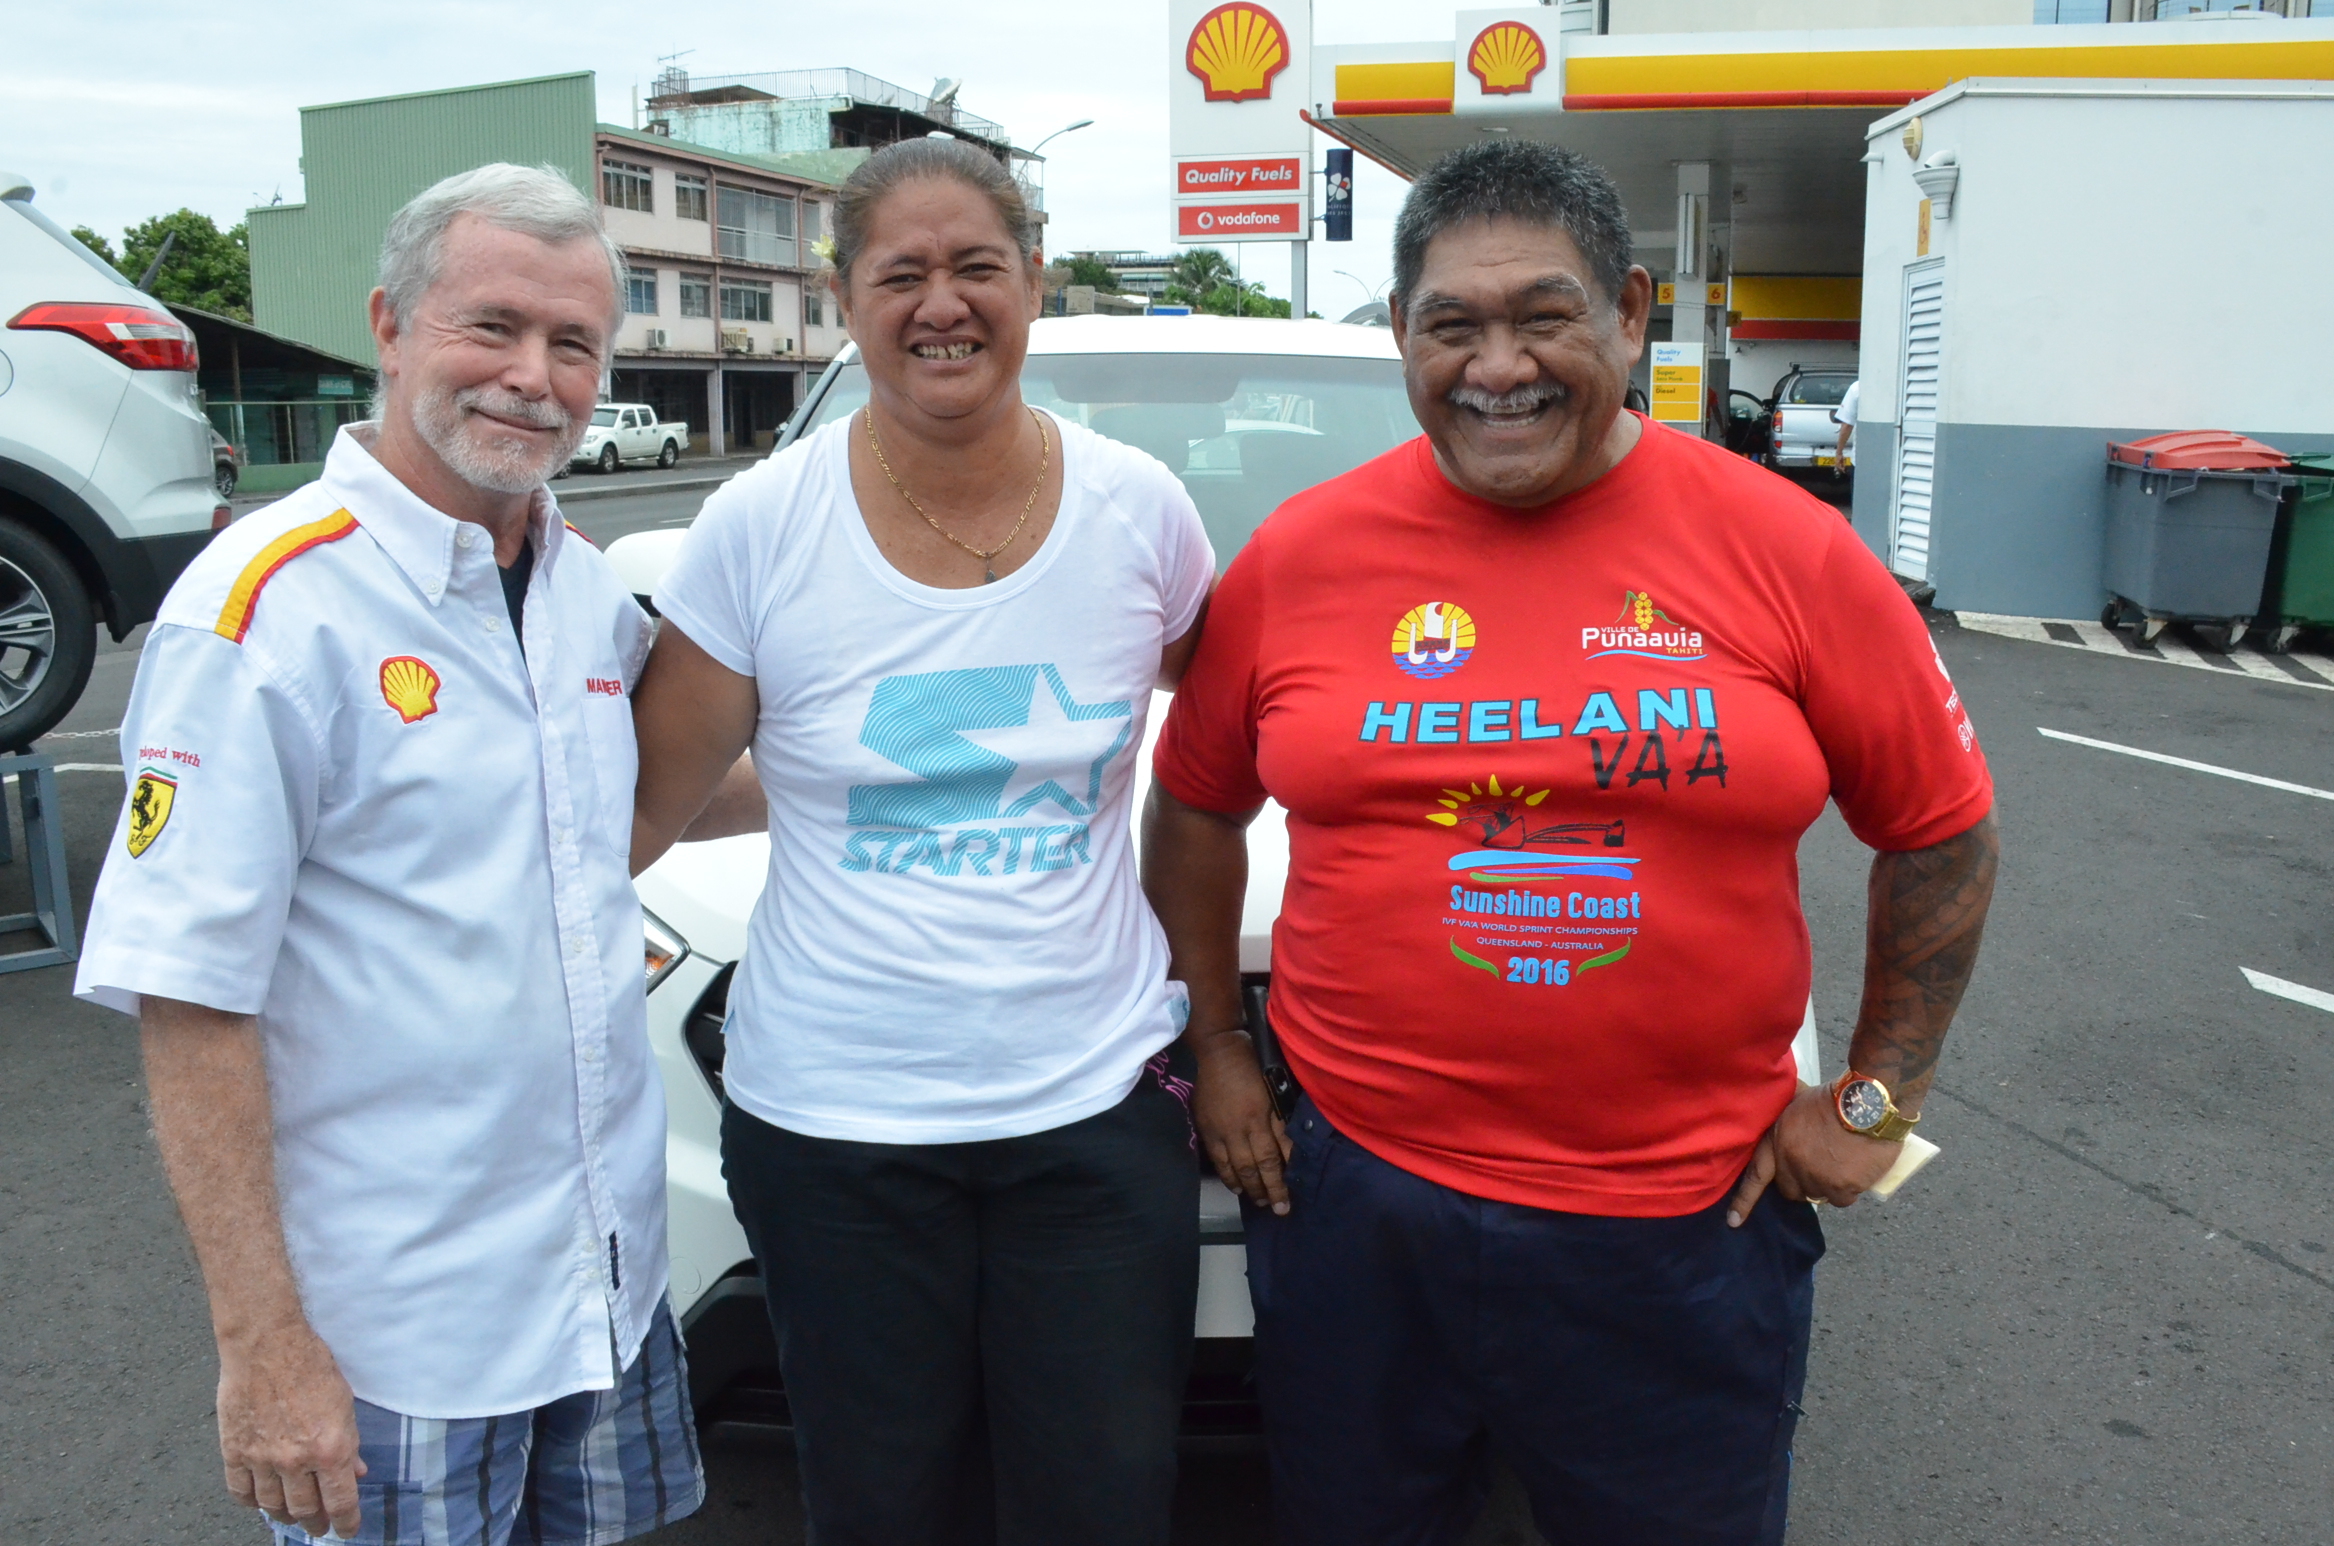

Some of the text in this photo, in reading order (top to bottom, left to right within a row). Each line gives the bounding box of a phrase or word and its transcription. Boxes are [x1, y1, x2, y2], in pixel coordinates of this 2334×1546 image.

[1185, 165, 1293, 186] Quality Fuels
[1217, 211, 1280, 225] vodafone
[1662, 287, 1671, 299] 5
[1711, 287, 1721, 299] 6
[1582, 627, 1703, 649] Punaauia
[1666, 647, 1703, 655] TAHITI
[1359, 687, 1718, 744] HEELANI
[172, 750, 201, 768] with
[1590, 726, 1729, 792] VA'A
[837, 823, 1093, 876] STARTER
[1450, 885, 1641, 919] Sunshine Coast
[1442, 917, 1638, 935] IVF VA'A WORLD SPRINT CHAMPIONSHIPS
[1476, 936, 1543, 948] QUEENSLAND
[1550, 941, 1604, 950] AUSTRALIA
[1507, 956, 1570, 986] 2016
